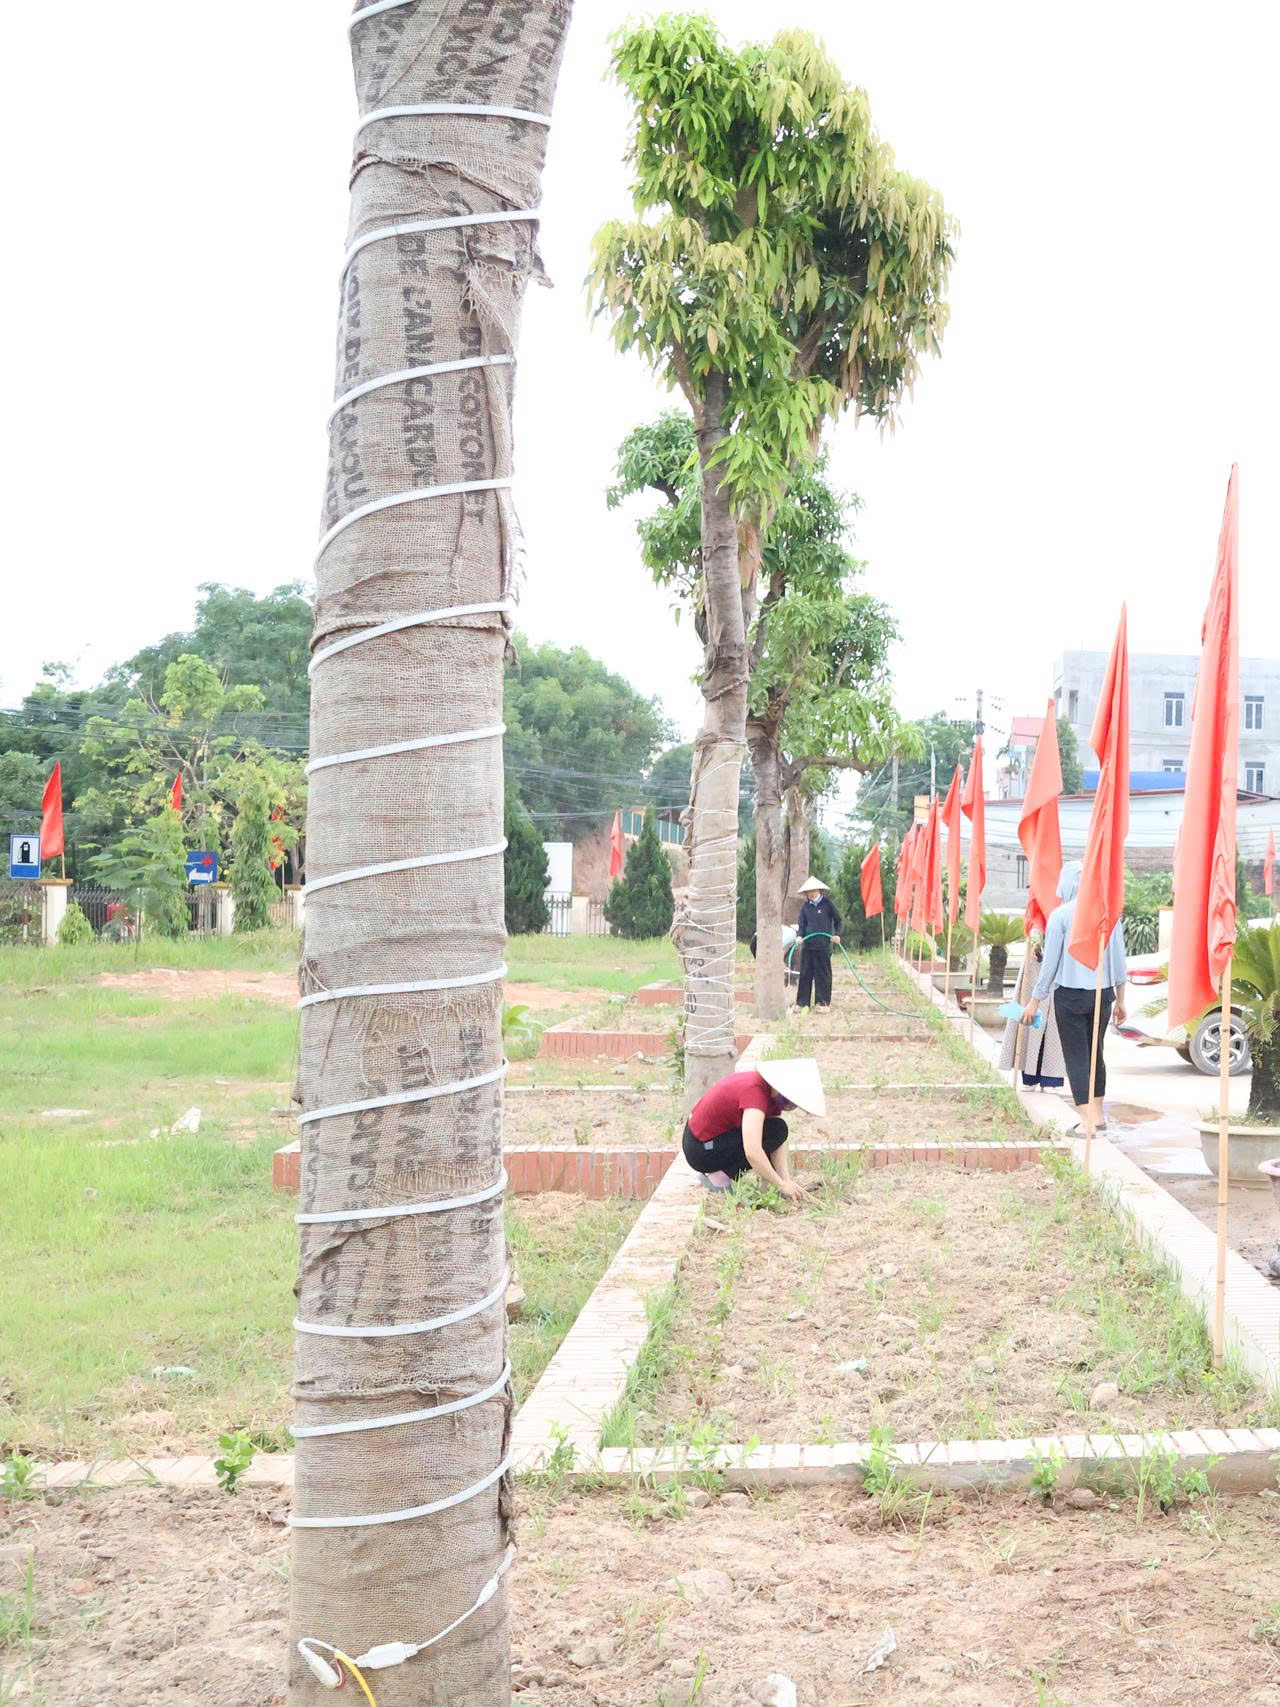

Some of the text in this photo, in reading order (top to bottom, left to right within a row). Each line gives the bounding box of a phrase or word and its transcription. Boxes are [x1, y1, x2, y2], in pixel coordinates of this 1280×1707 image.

[397, 234, 430, 277] DE
[337, 398, 368, 499] AJOU
[457, 375, 487, 482] COTON
